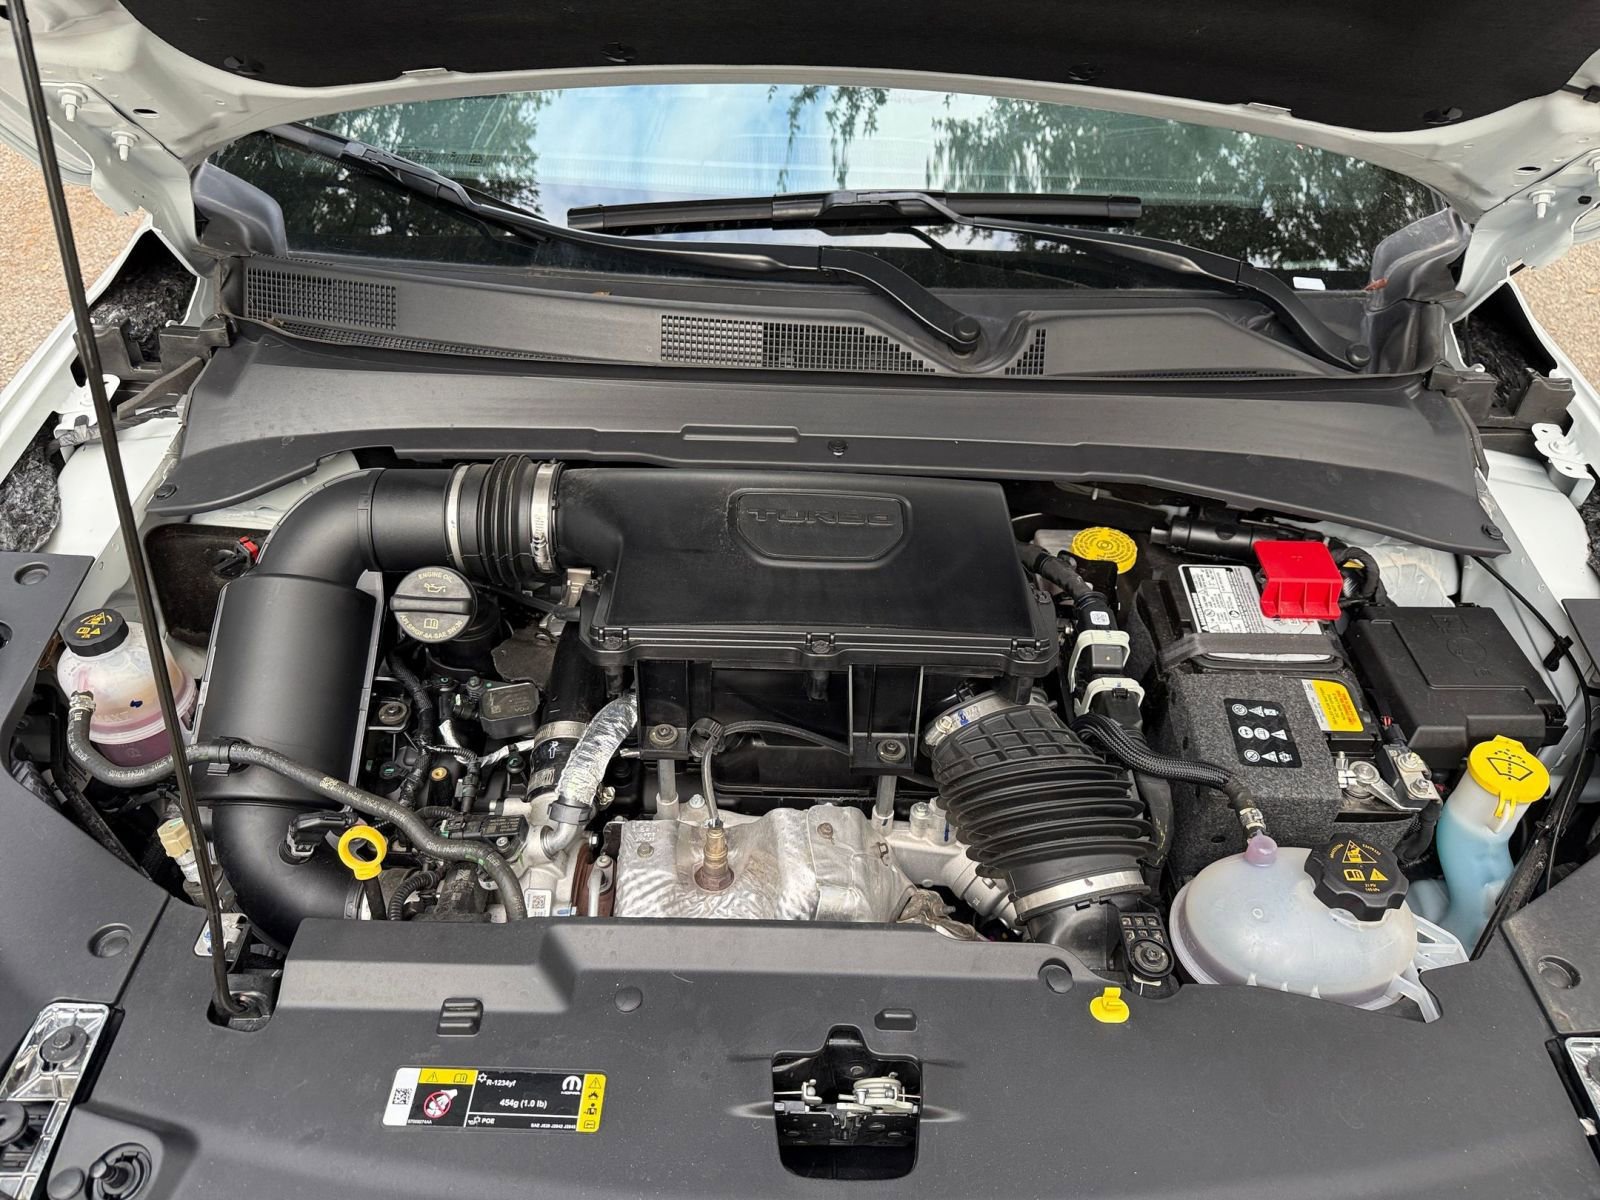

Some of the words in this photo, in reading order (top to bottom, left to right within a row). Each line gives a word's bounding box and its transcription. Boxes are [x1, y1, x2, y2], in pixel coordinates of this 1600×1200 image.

[747, 508, 895, 526] TURBO
[418, 571, 442, 580] ENGINE
[442, 574, 453, 584] OIL
[486, 1079, 516, 1088] R-1234yf
[499, 1099, 519, 1108] 454g
[520, 1099, 535, 1109] (1.0
[536, 1100, 548, 1109] lb)
